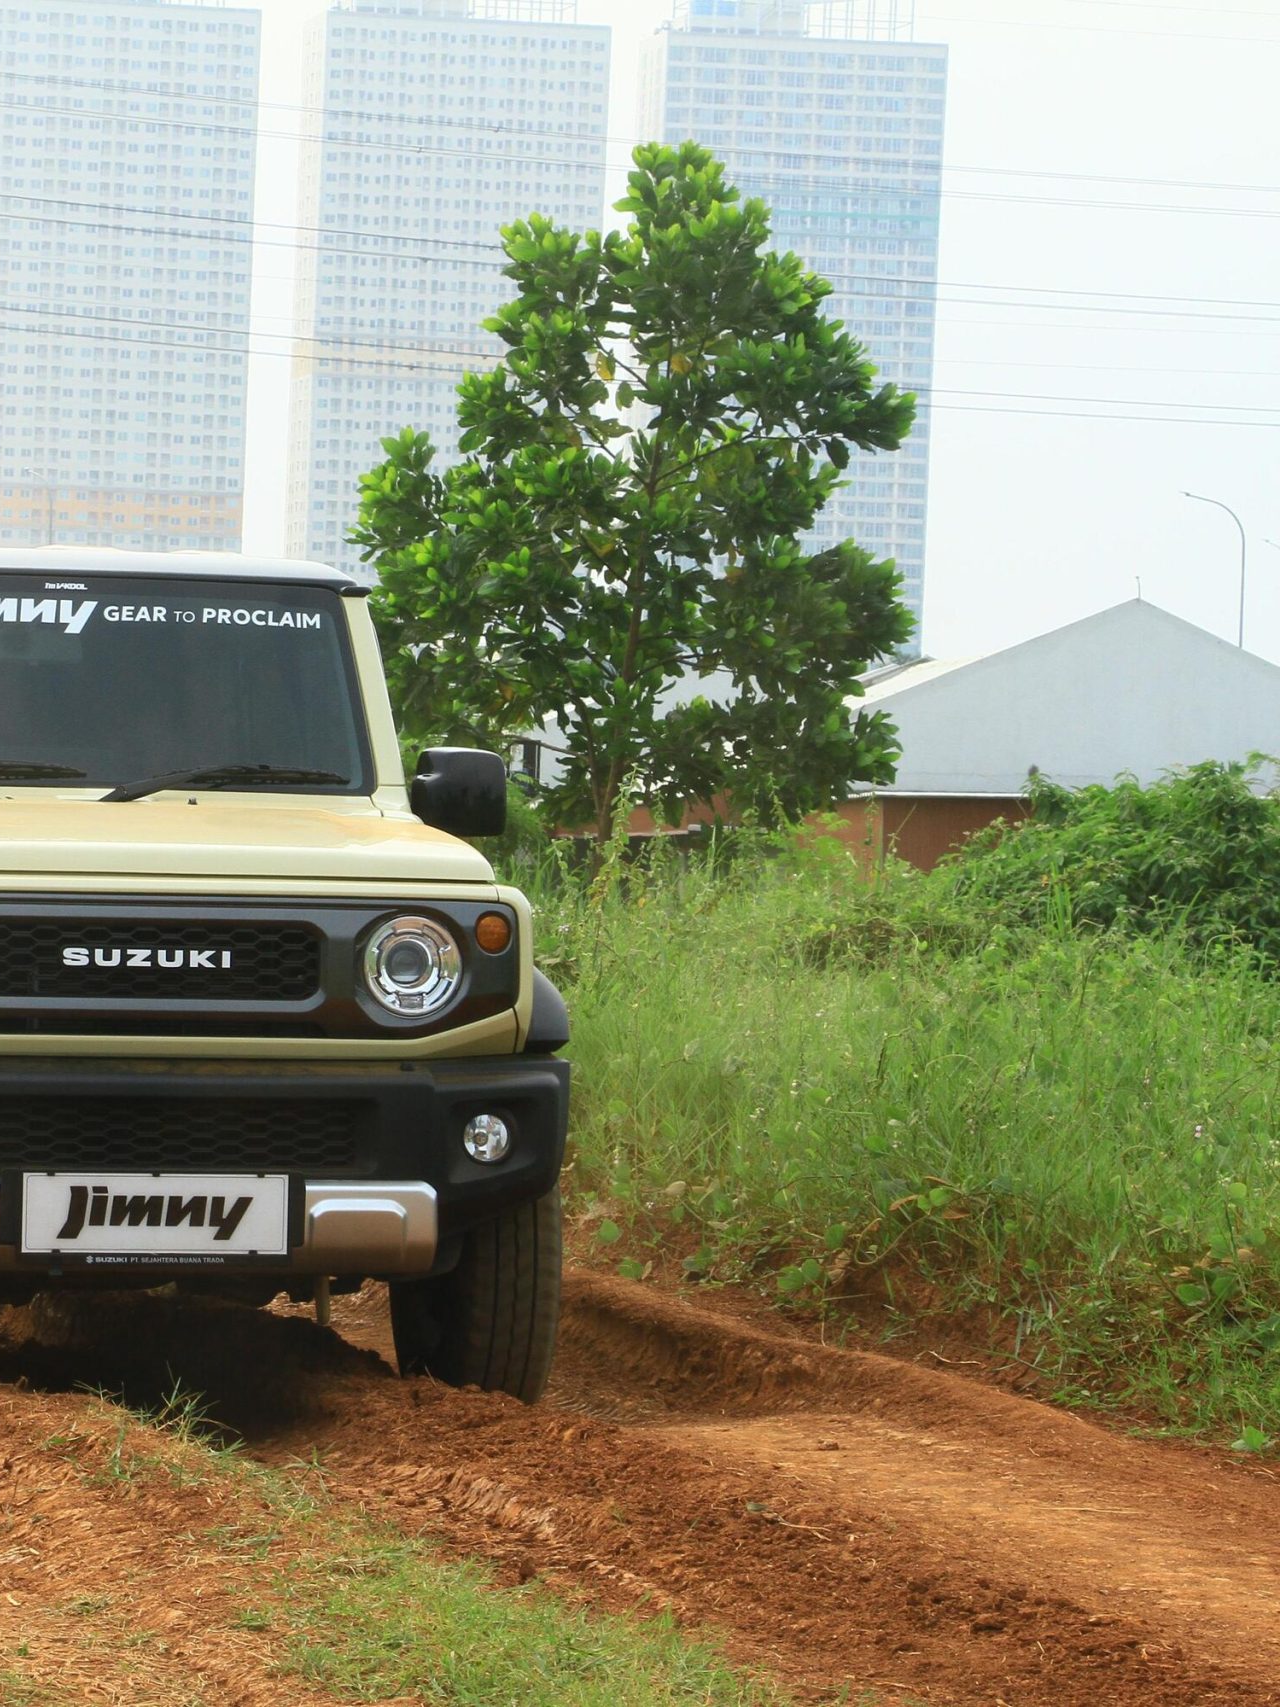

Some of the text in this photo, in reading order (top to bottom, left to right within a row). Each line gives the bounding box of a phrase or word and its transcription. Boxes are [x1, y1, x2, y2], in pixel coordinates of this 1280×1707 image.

[103, 606, 167, 622] GEAR
[173, 611, 196, 623] TO
[202, 608, 321, 629] PROCLAIM
[62, 947, 231, 968] SUZUKI
[56, 1186, 253, 1240] Jimny
